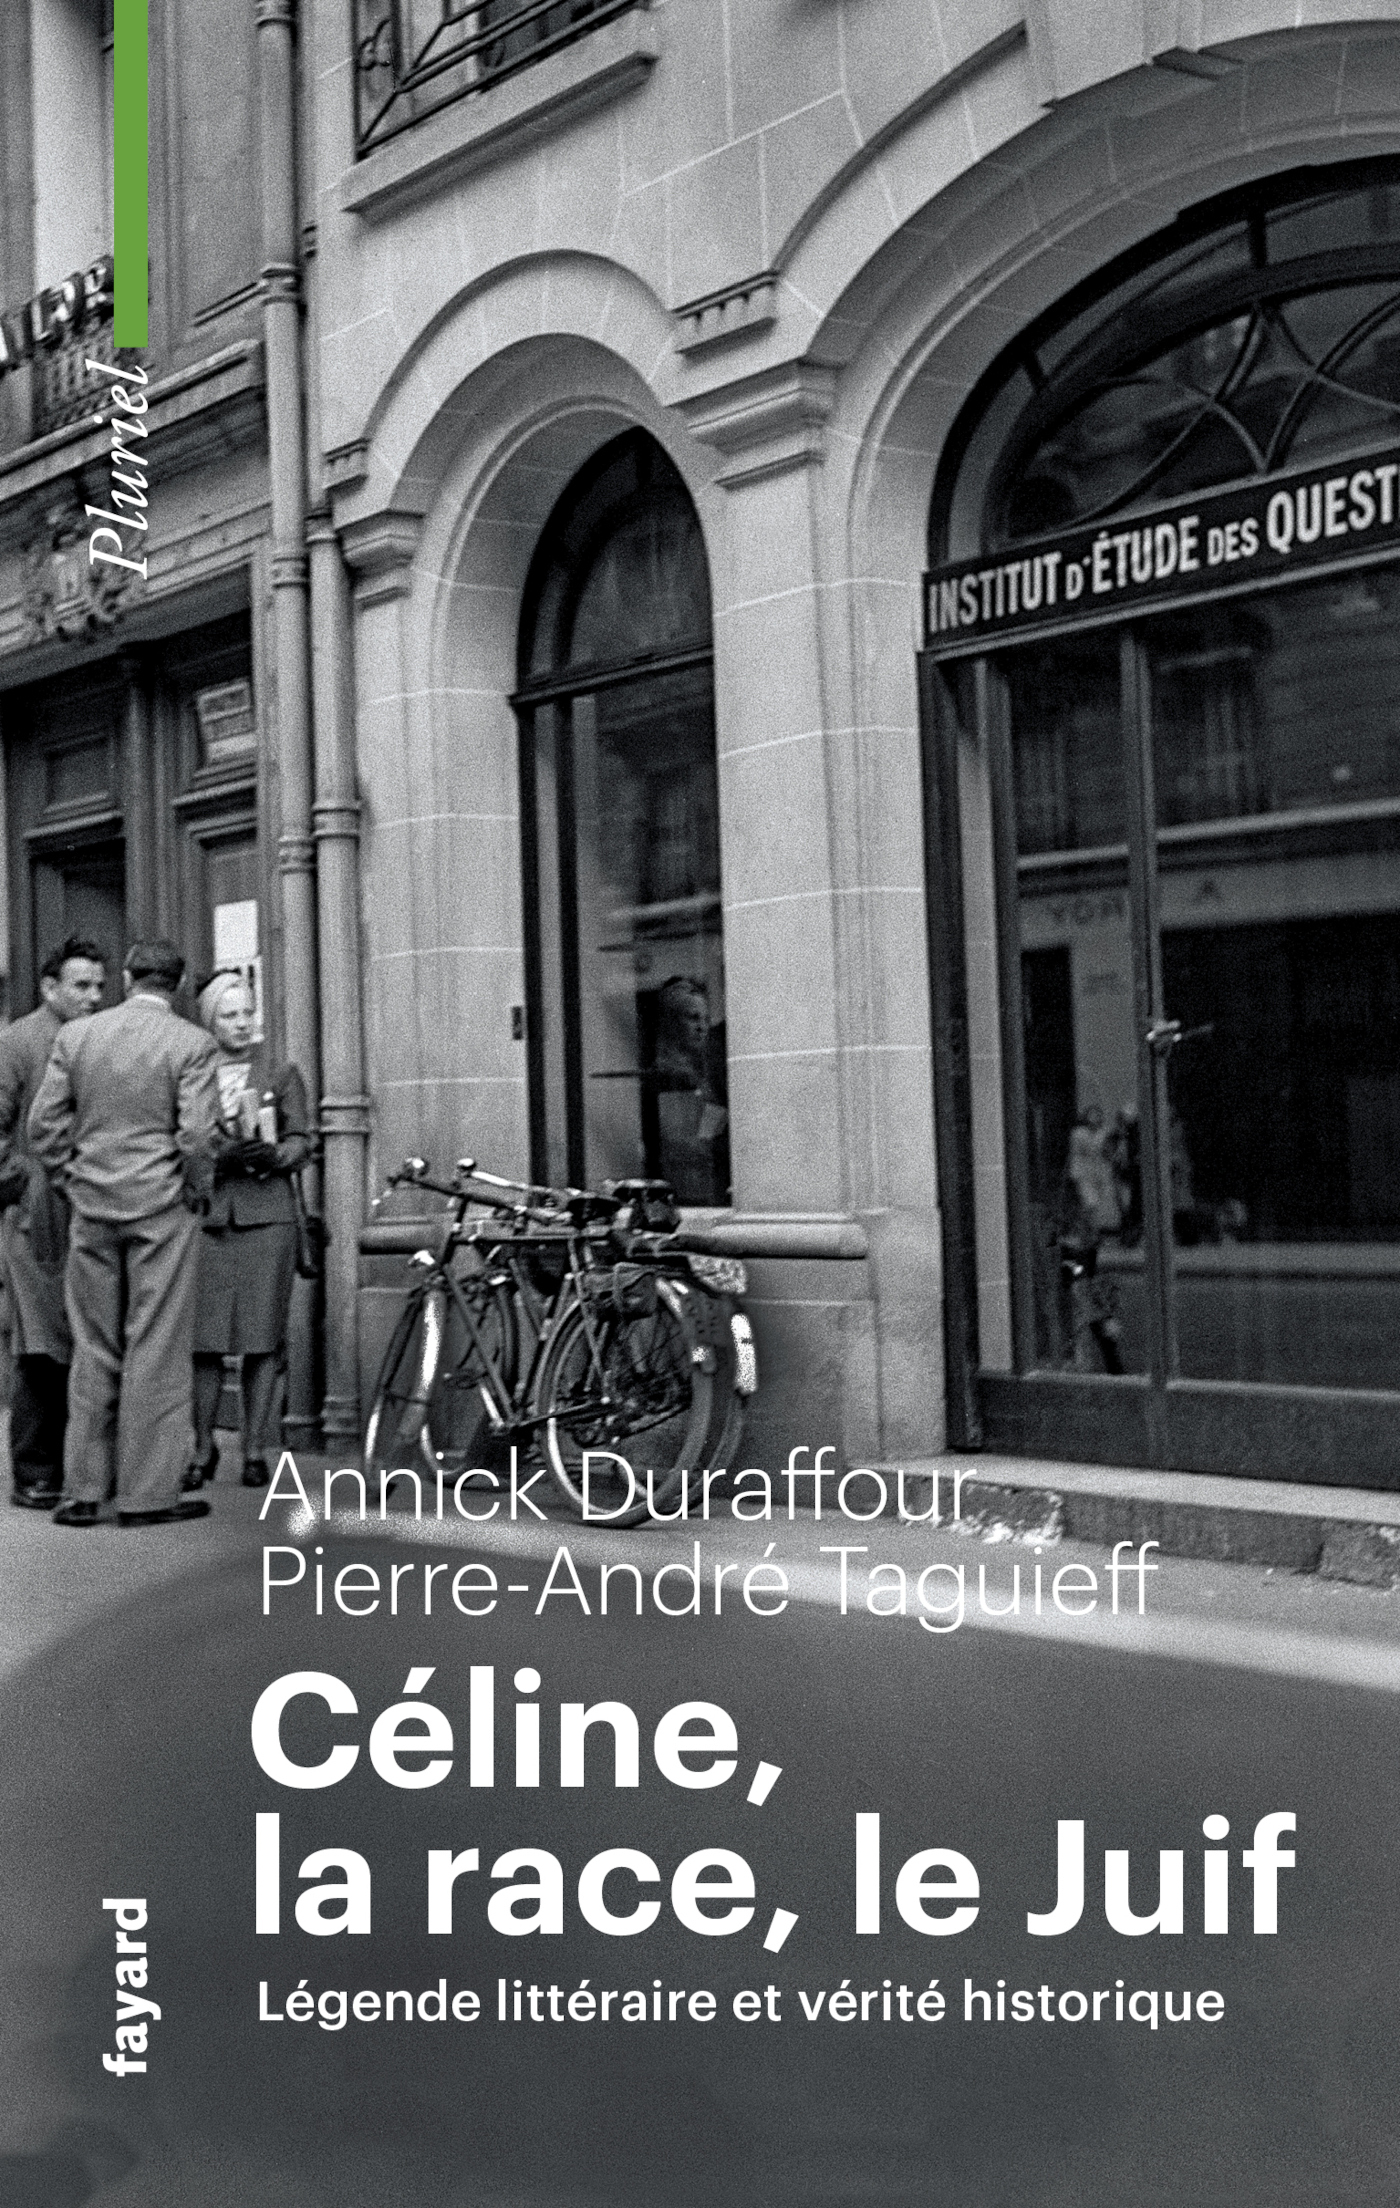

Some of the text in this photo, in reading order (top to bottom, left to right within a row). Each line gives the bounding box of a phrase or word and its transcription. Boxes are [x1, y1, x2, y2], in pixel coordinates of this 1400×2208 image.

[928, 550, 1062, 634] INSTITUT
[1207, 517, 1260, 567] DES
[1266, 463, 1400, 555] QUEST
